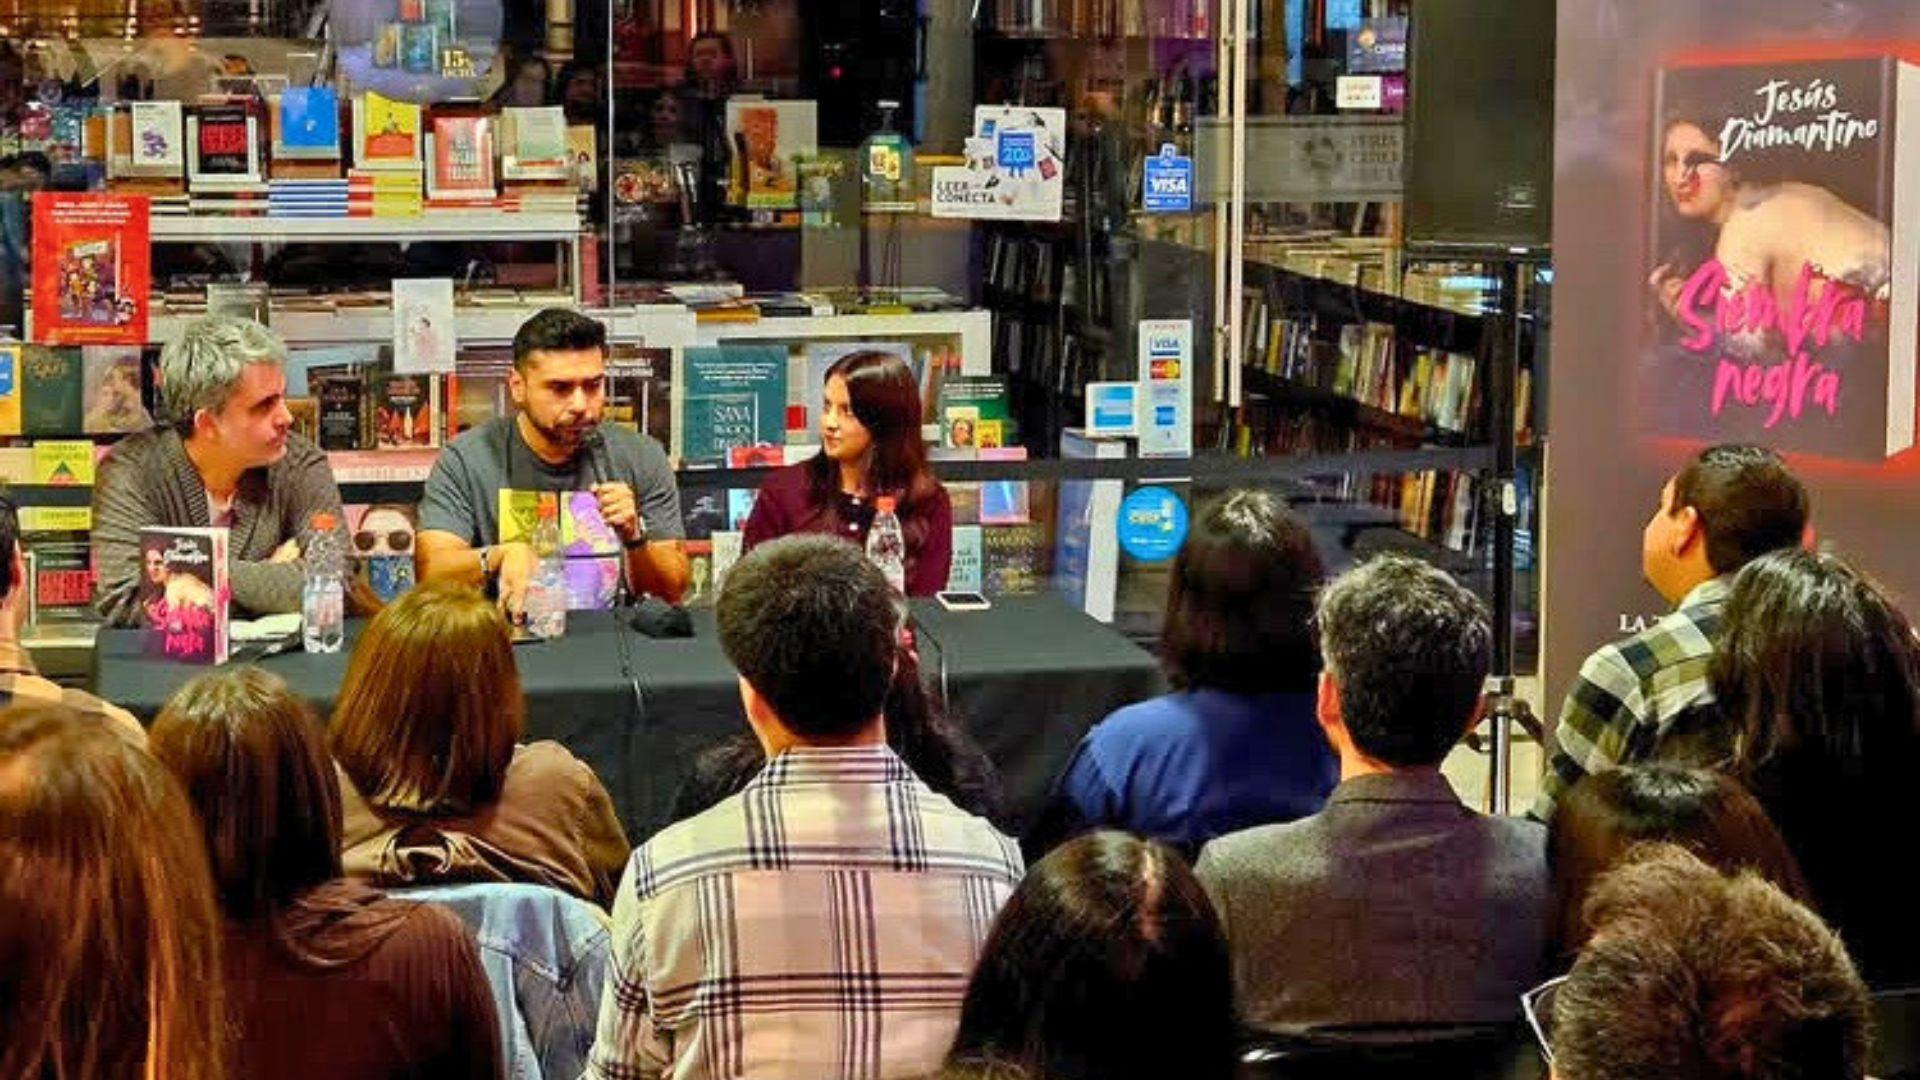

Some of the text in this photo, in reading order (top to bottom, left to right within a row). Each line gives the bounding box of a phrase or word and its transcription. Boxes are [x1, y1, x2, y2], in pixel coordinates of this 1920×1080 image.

[1754, 78, 1837, 126] Jesús
[1718, 110, 1878, 162] Diamantino
[937, 181, 968, 192] LEER
[1151, 177, 1187, 194] VISA
[937, 192, 995, 203] CONECTA
[1678, 259, 1867, 358] Siembra
[1154, 338, 1179, 349] VISA
[1713, 354, 1840, 429] negra
[1619, 613, 1648, 633] LA
